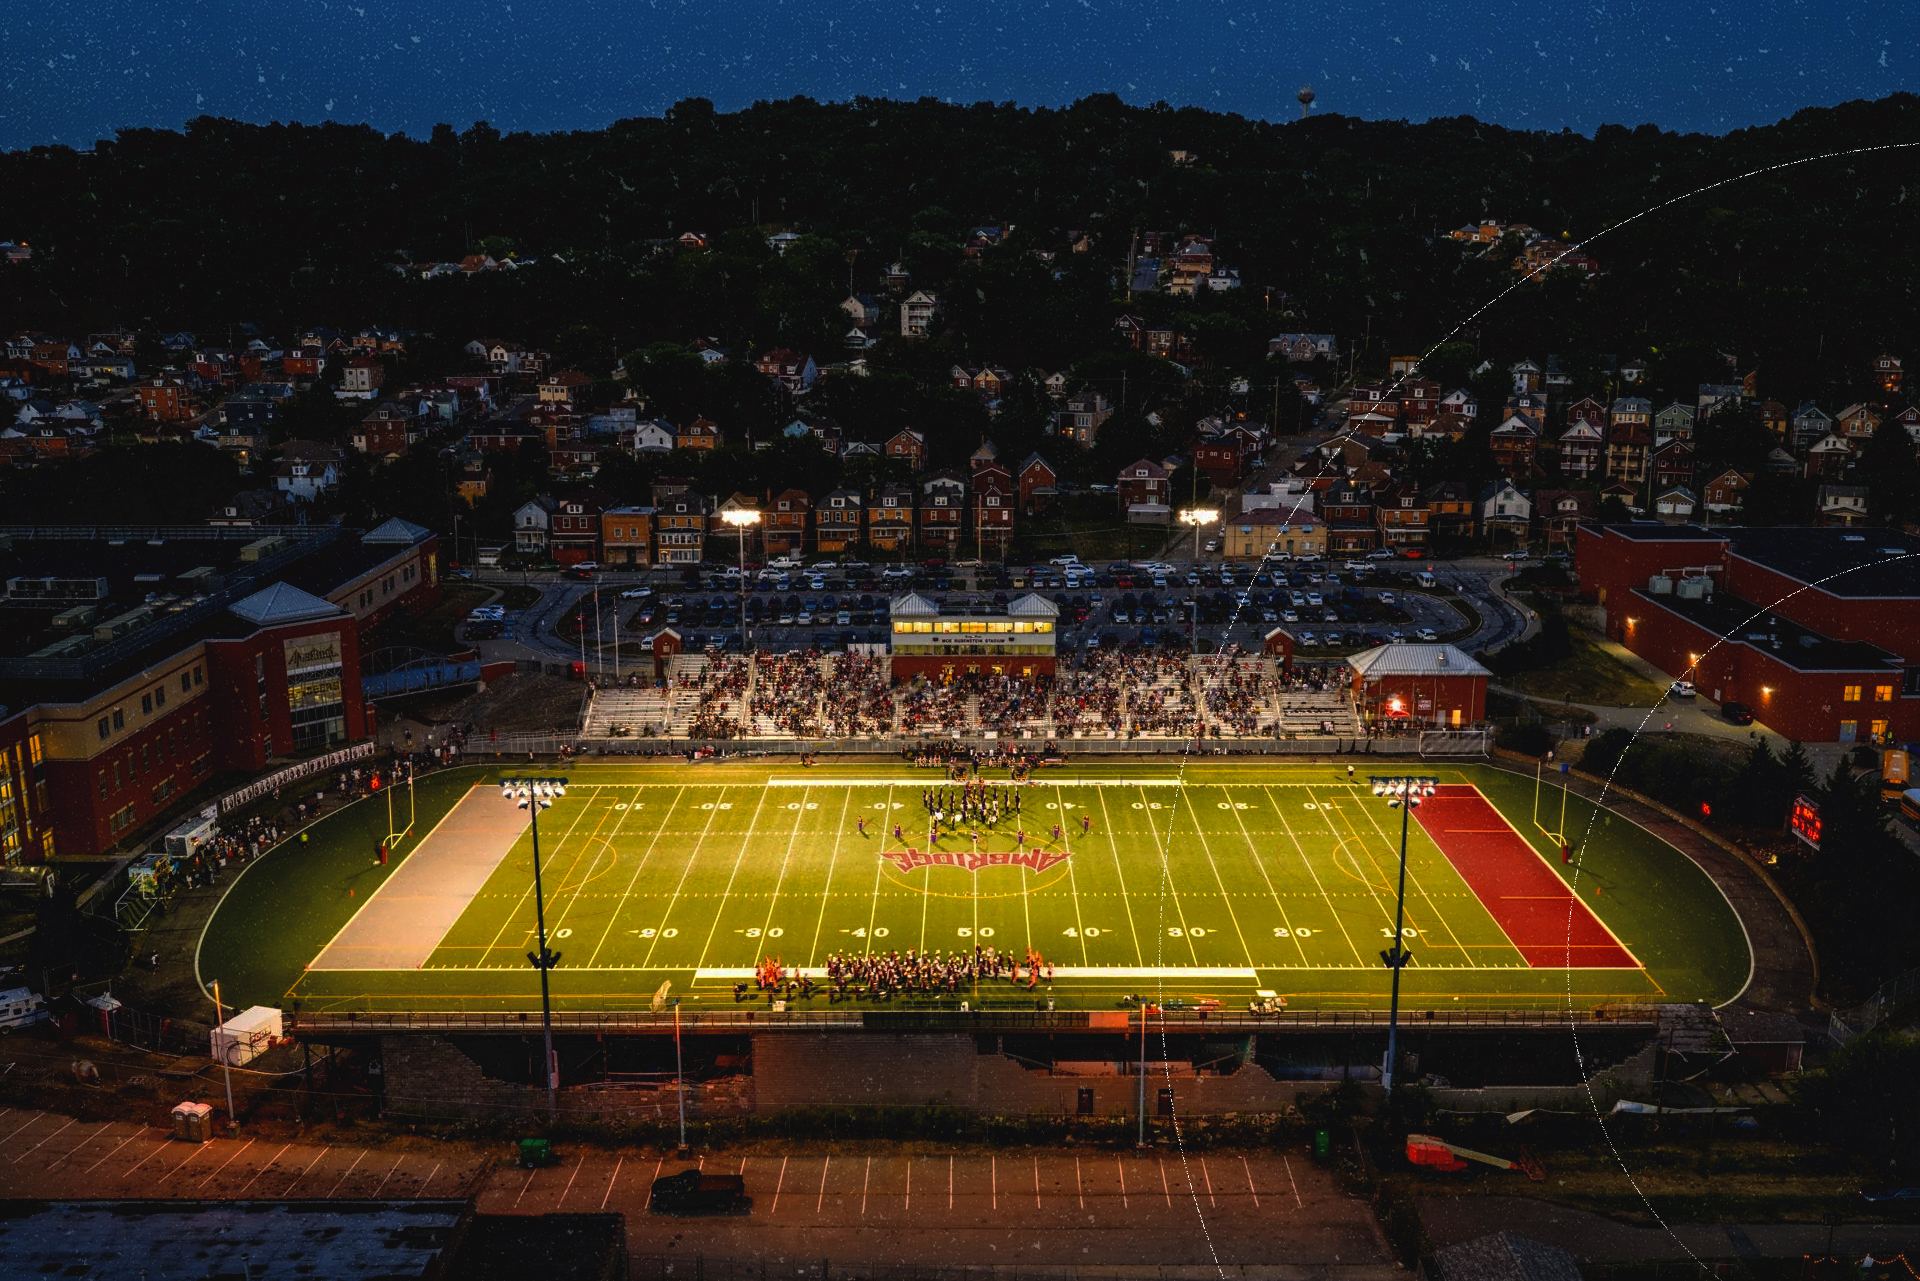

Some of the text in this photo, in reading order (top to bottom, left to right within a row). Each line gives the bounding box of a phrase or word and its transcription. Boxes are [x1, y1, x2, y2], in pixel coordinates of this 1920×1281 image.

[880, 848, 1073, 874] AMBRIDGE
[639, 928, 678, 938] 20
[746, 928, 784, 938] 30
[851, 928, 889, 938] 40
[958, 928, 995, 938] 50
[1063, 928, 1100, 938] 40
[1168, 928, 1206, 938] 30
[1274, 928, 1311, 938] 20
[1380, 928, 1418, 938] 10
